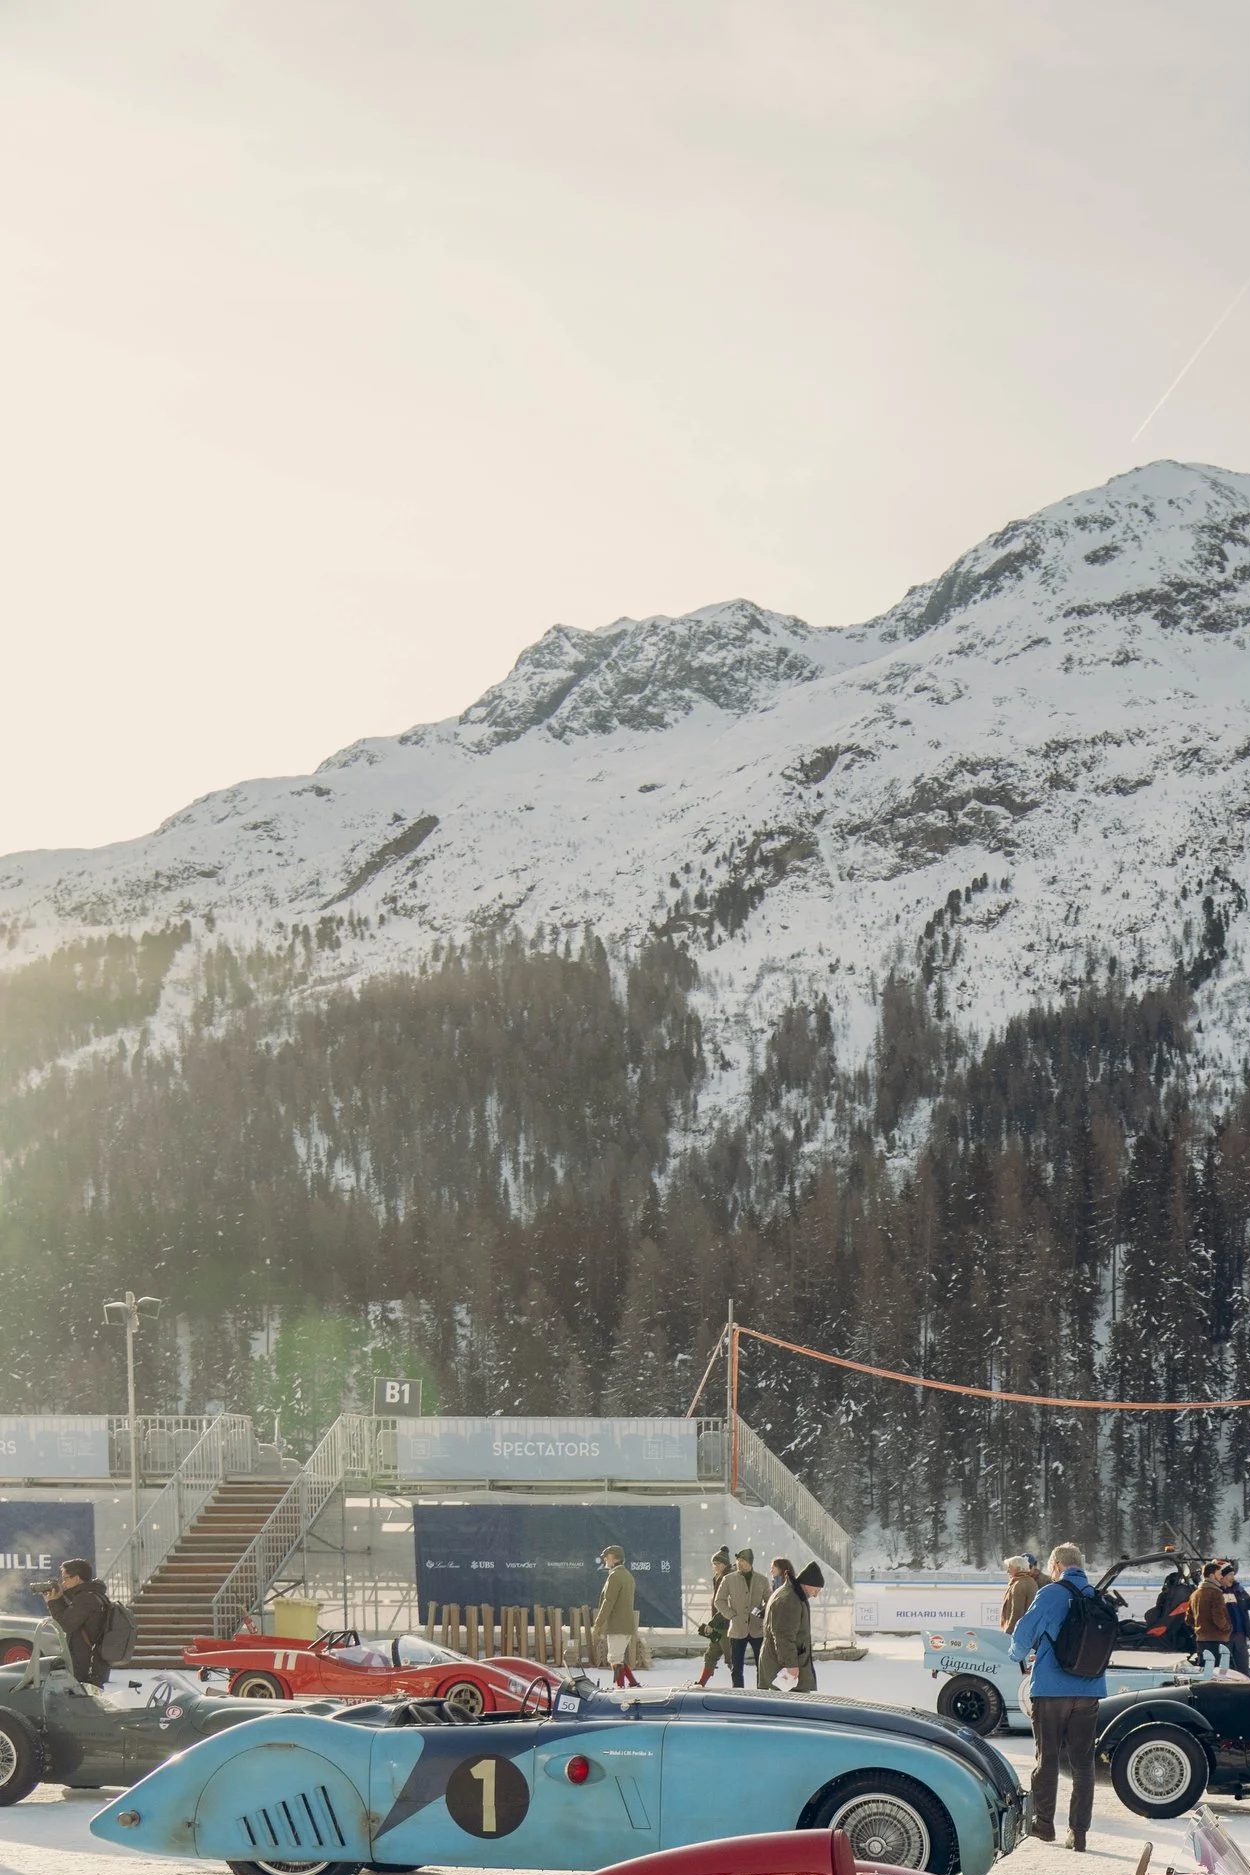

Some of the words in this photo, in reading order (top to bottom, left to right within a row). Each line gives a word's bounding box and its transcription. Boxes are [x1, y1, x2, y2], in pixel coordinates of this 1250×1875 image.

[385, 1381, 410, 1405] B1
[492, 1442, 600, 1458] SPECTATORS
[0, 1553, 52, 1569] ILLE
[479, 1561, 495, 1569] UBS
[273, 1651, 299, 1671] 11
[940, 1655, 999, 1675] Gigandet
[560, 1702, 576, 1711] 50
[470, 1759, 497, 1832] 1
